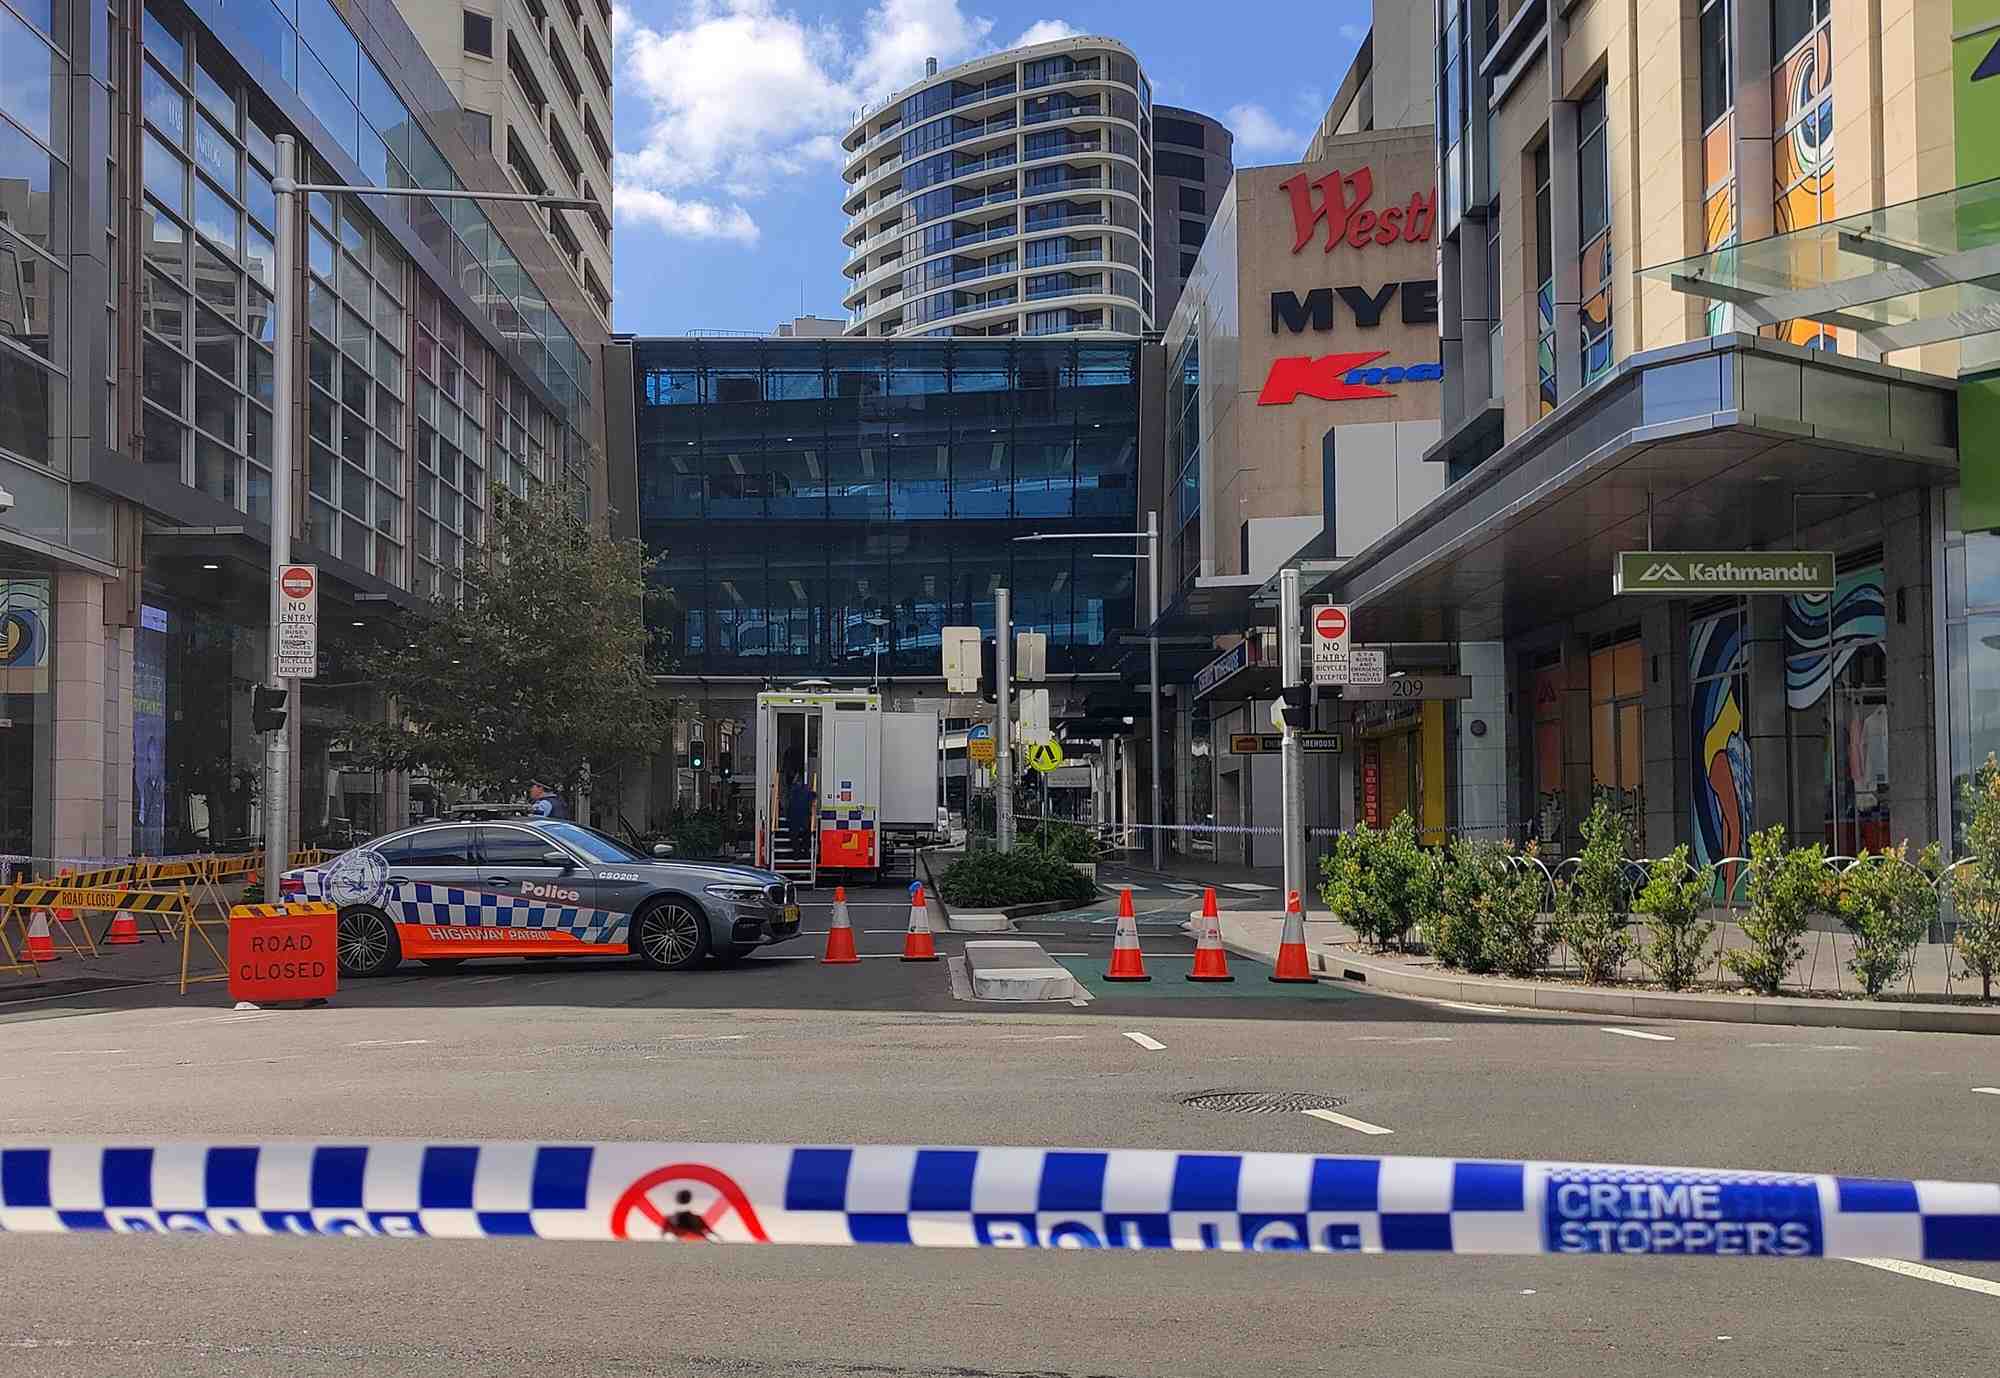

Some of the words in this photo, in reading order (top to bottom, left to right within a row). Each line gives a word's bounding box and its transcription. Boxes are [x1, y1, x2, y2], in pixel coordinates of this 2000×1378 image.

[1688, 562, 1818, 582] Kathmandu
[288, 602, 306, 612] NO
[281, 614, 312, 622] ENTRY
[1323, 642, 1340, 651] NO
[1316, 653, 1346, 661] ENTRY
[1392, 680, 1423, 696] 209
[521, 881, 580, 901] Police
[62, 892, 83, 905] ROAD
[86, 893, 116, 907] CLOSED
[427, 928, 504, 941] HIGHWAY
[509, 929, 551, 941] PATROL
[252, 935, 313, 952] ROAD
[240, 961, 325, 980] CLOSED
[1556, 1183, 1722, 1219] CRIME
[1558, 1221, 1811, 1255] STOPPERS
